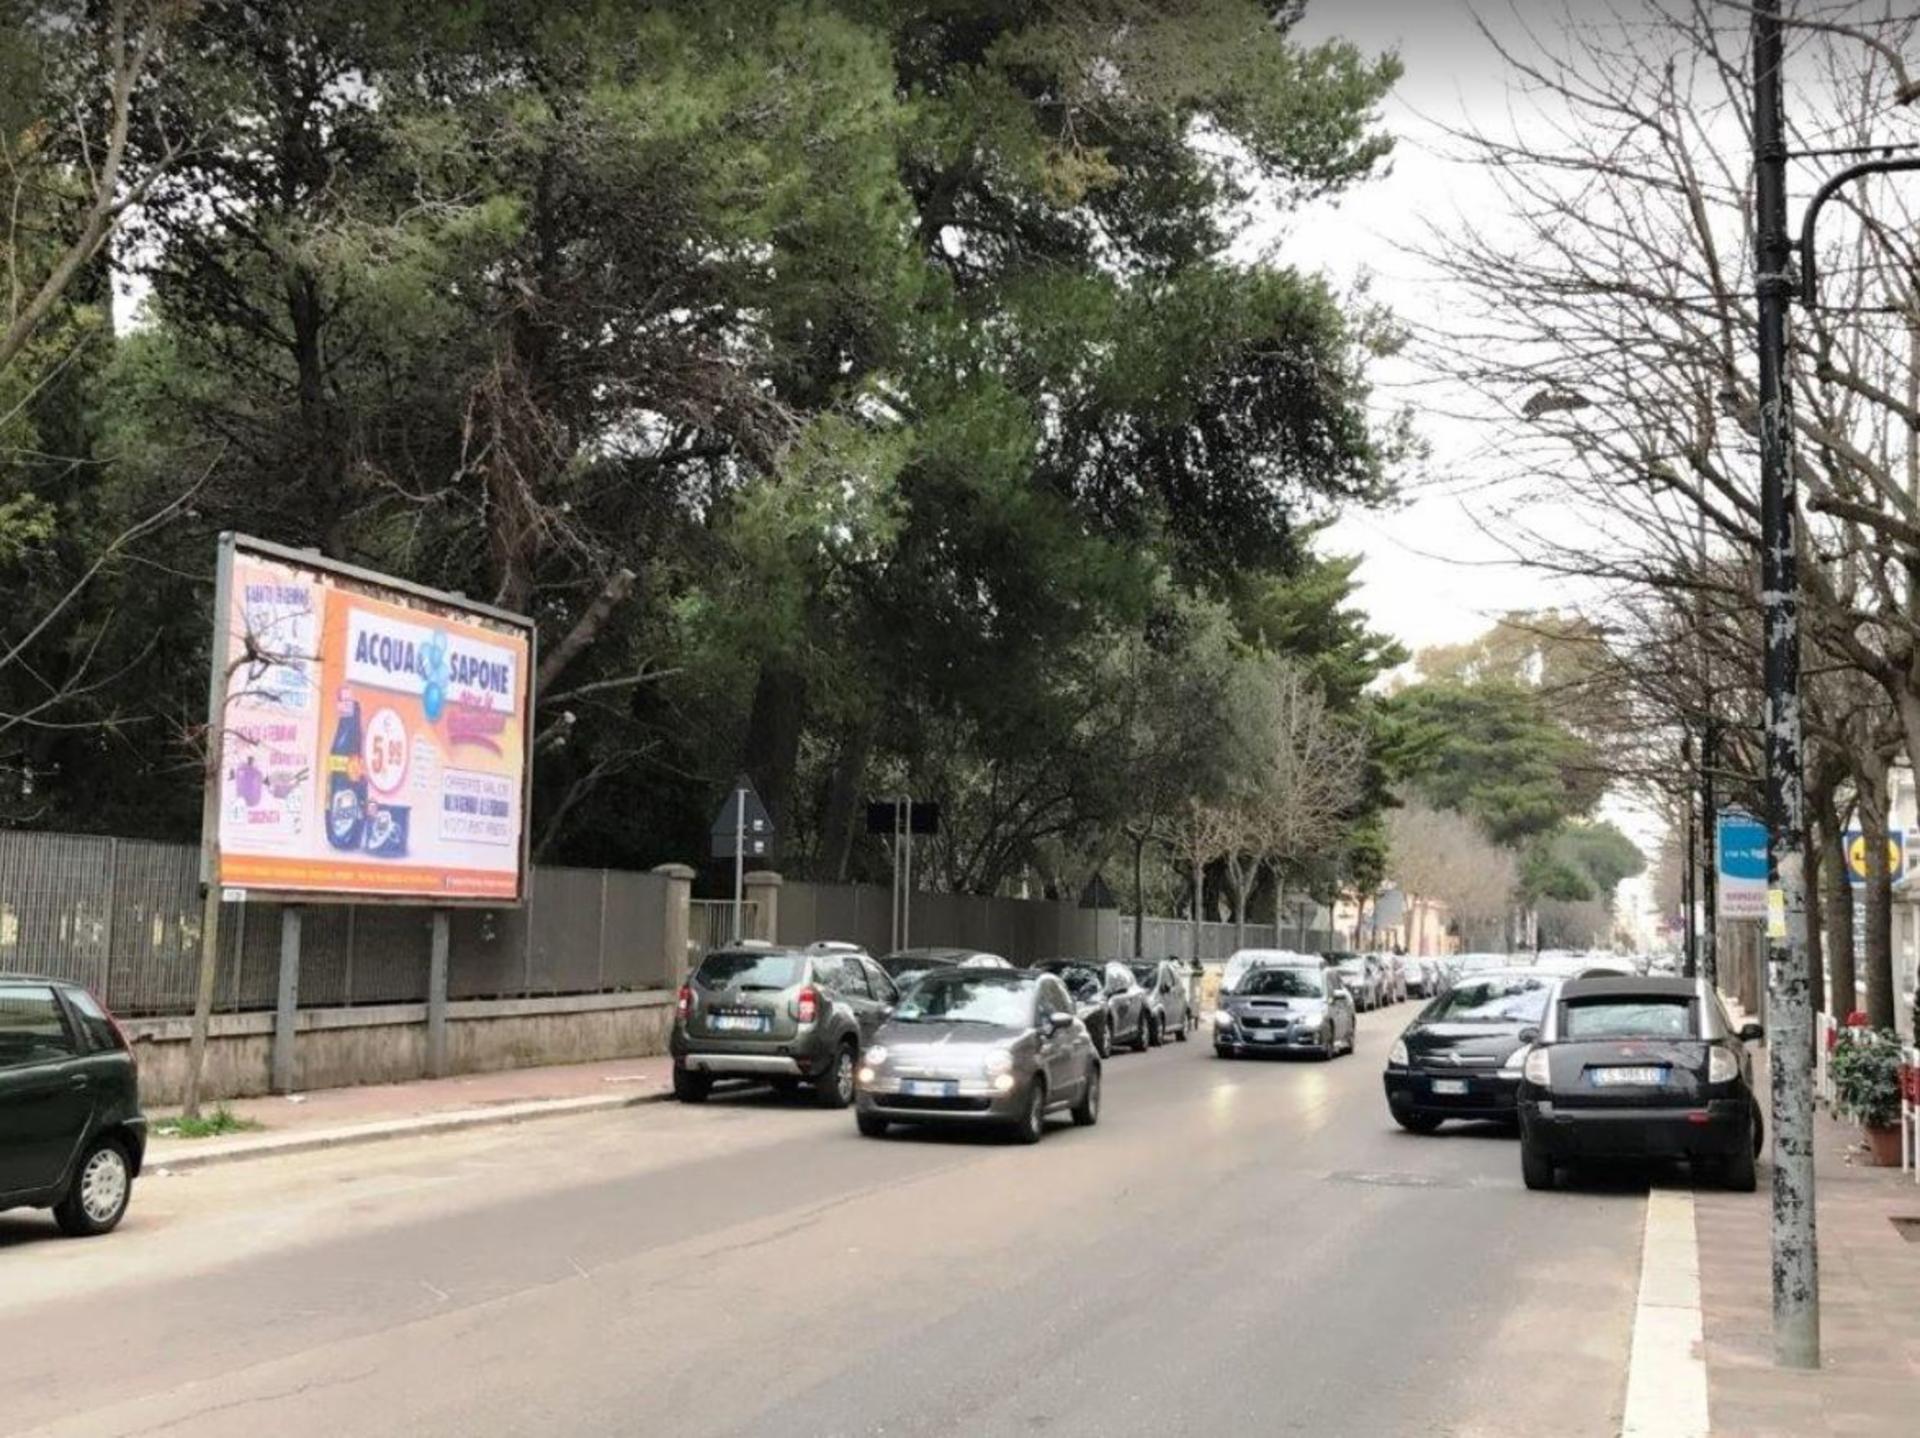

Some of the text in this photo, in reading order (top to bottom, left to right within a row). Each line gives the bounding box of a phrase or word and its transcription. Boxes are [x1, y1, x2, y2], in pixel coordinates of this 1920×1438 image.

[355, 630, 415, 675] ACQUA
[450, 651, 509, 694] SAPONE
[372, 736, 383, 774] 5
